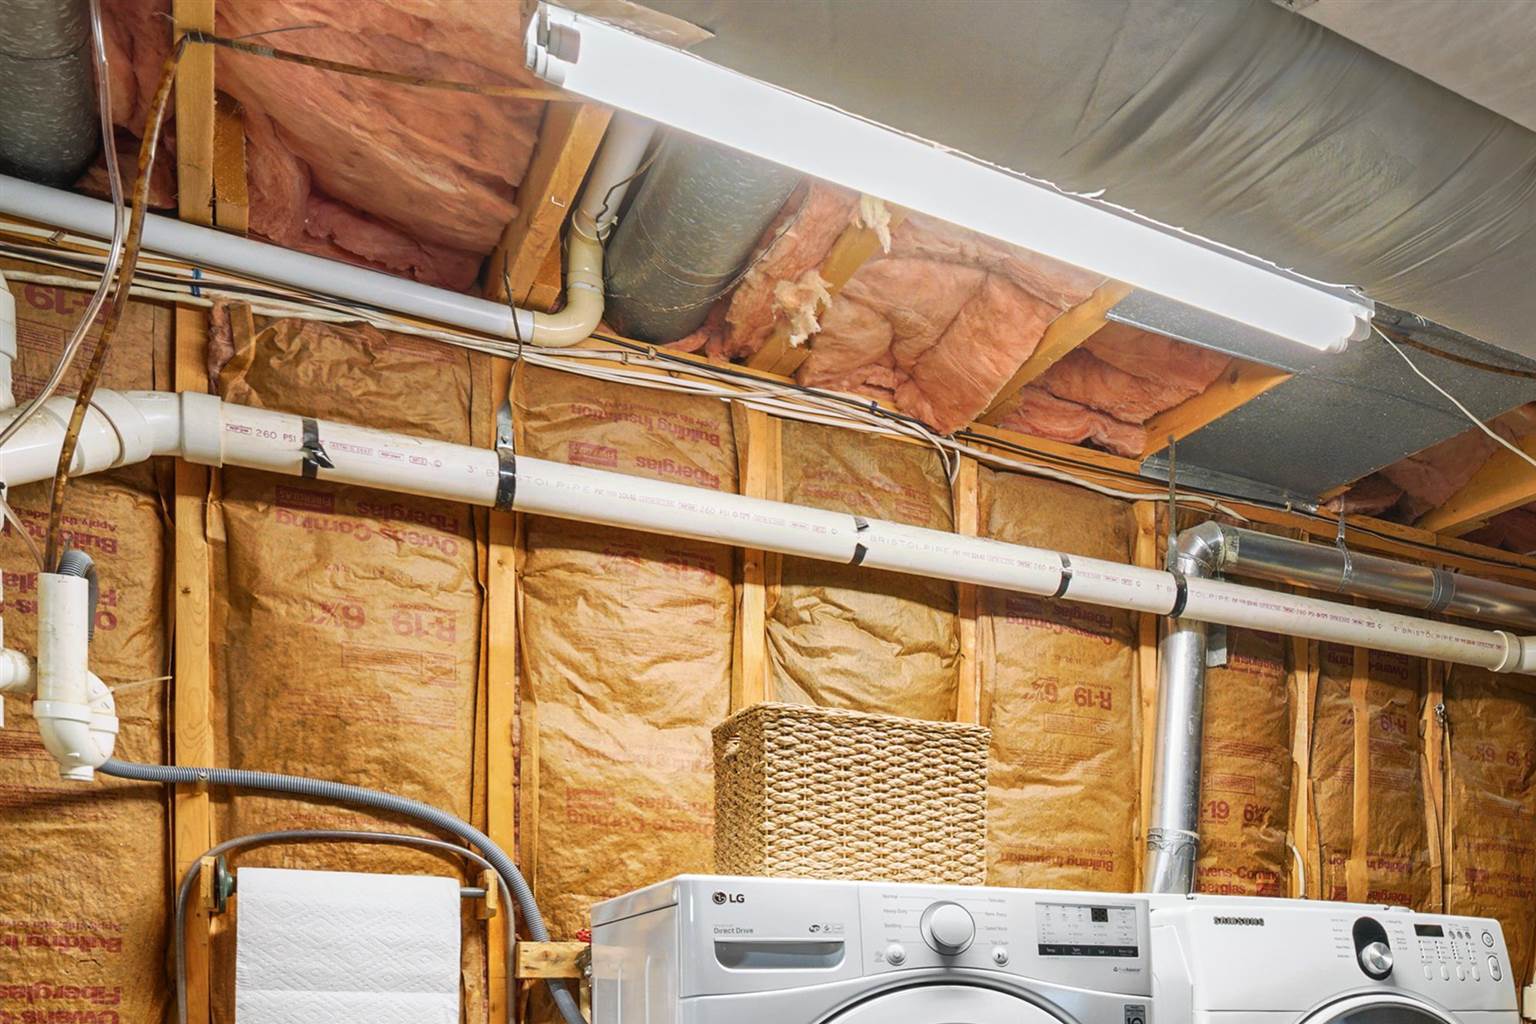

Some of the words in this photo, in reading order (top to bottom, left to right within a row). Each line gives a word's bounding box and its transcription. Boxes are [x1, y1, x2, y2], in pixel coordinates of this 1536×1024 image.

[254, 427, 279, 442] 260
[635, 456, 720, 491] Fiberglas
[390, 611, 457, 643] R-19
[1073, 686, 1113, 712] R-19
[1197, 866, 1280, 889] wens-Corning
[729, 893, 746, 904] LG
[713, 926, 736, 935] Direct
[737, 926, 755, 935] Drive
[1213, 916, 1265, 927] SAMSUNG
